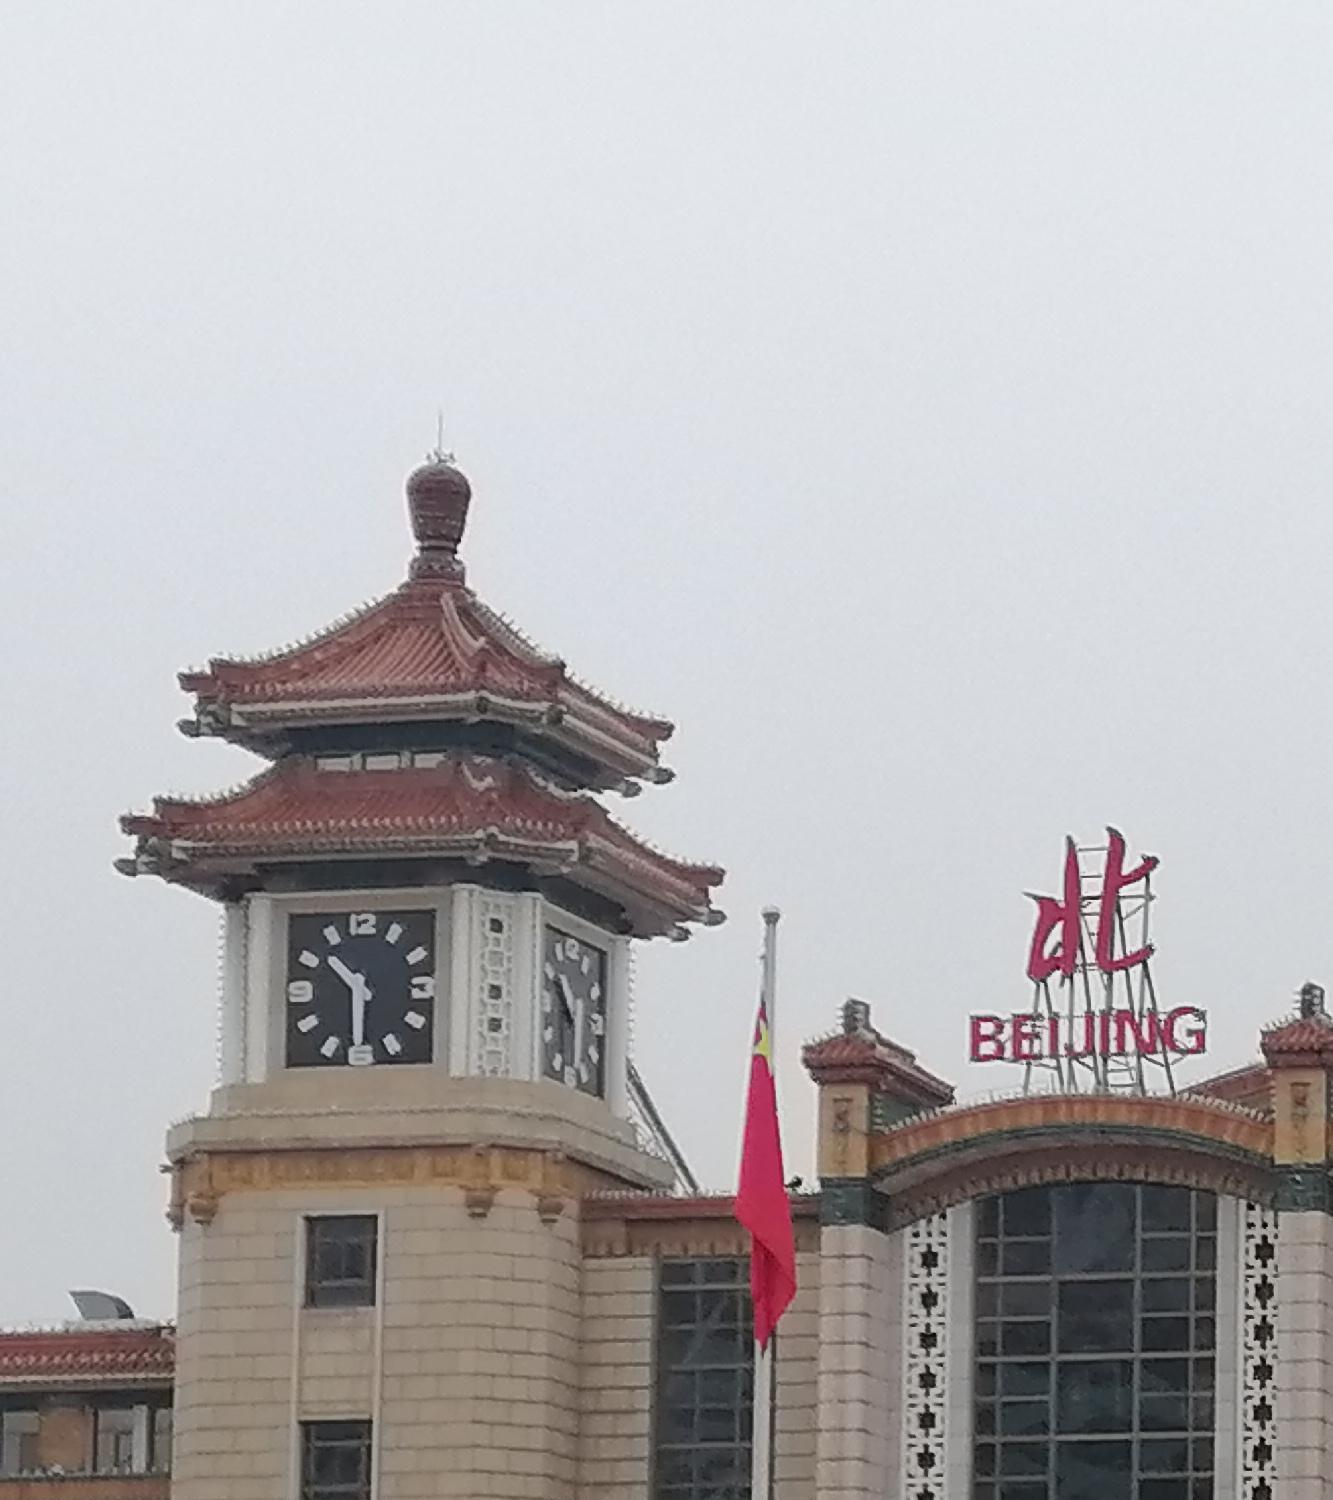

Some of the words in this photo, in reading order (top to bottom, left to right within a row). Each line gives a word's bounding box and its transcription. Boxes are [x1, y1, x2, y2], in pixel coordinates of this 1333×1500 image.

[350, 913, 377, 936] 12
[288, 980, 313, 1003] 9
[410, 976, 435, 999] 3
[969, 1005, 1207, 1062] BEIJING
